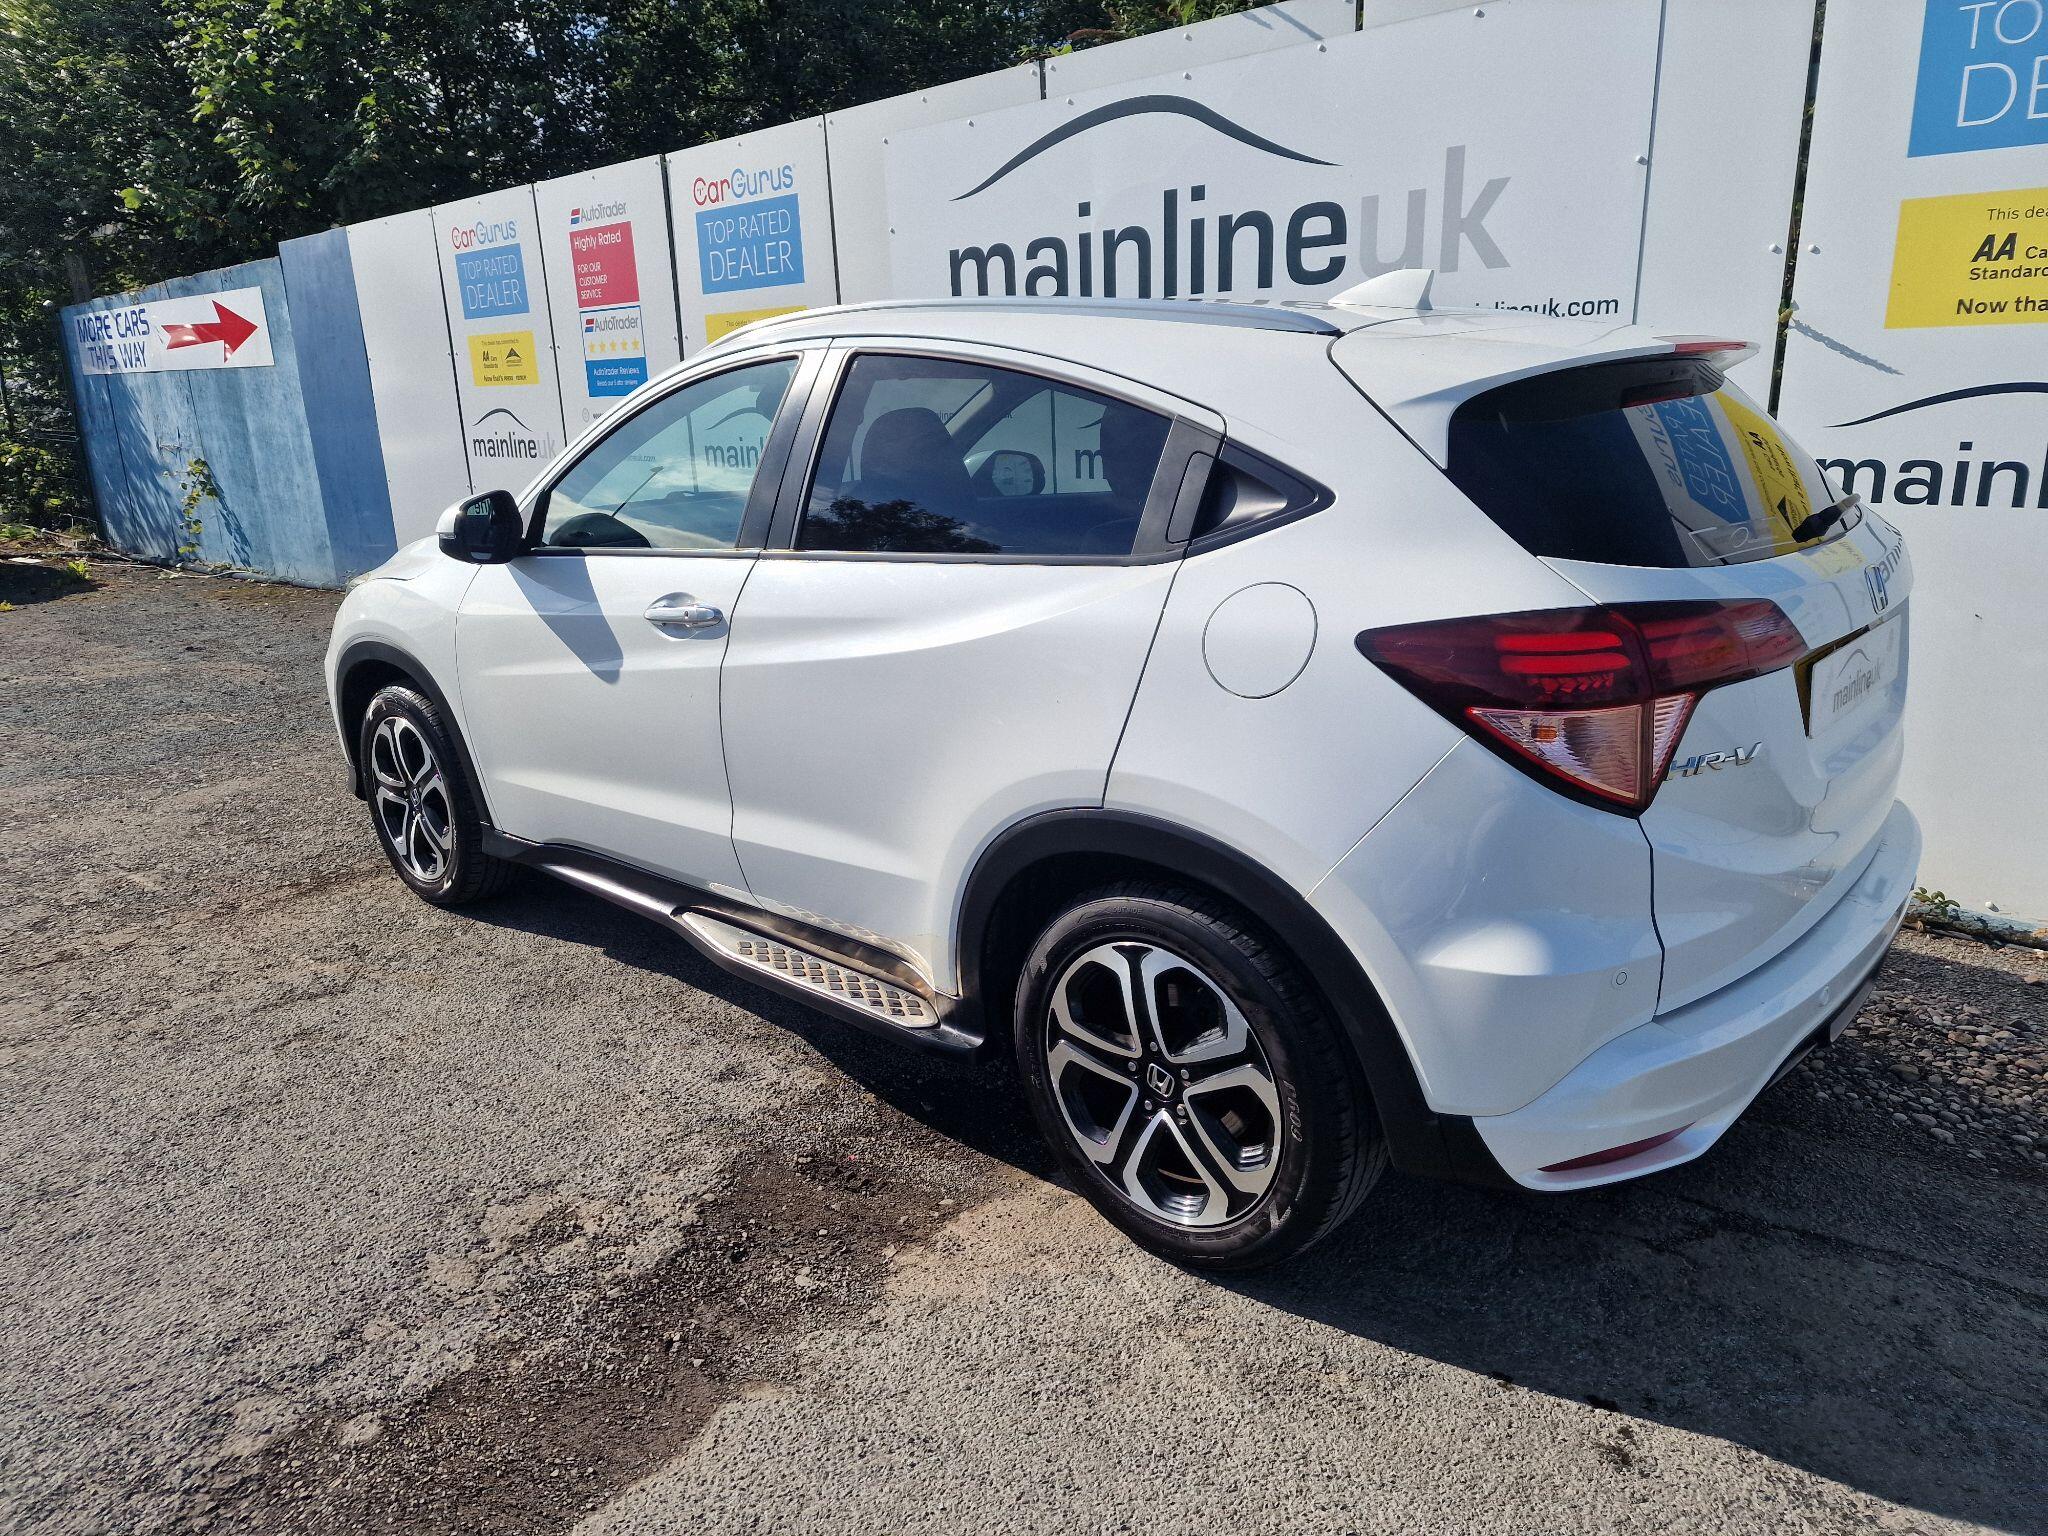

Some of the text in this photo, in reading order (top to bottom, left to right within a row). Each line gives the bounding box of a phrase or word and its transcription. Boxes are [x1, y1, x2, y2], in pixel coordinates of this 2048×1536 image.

[693, 164, 794, 206] CarGurus
[581, 201, 627, 222] AutoTrader
[1987, 205, 2048, 220] This de
[451, 220, 517, 250] CarGurus
[704, 209, 791, 245] TOP RATED
[574, 230, 622, 251] Highly Rated
[1971, 232, 2018, 262] AA
[461, 254, 518, 280] TOP RATED
[577, 262, 601, 274] FOR OUR
[709, 240, 794, 282] DEALER
[579, 274, 608, 287] CUSTOMER
[466, 279, 522, 310] DEALER
[580, 288, 602, 300] SERVICE
[1956, 298, 2008, 314] Now
[77, 308, 150, 343] MORE CARS
[594, 315, 639, 332] AutoTrader
[88, 341, 147, 370] THIS WAY
